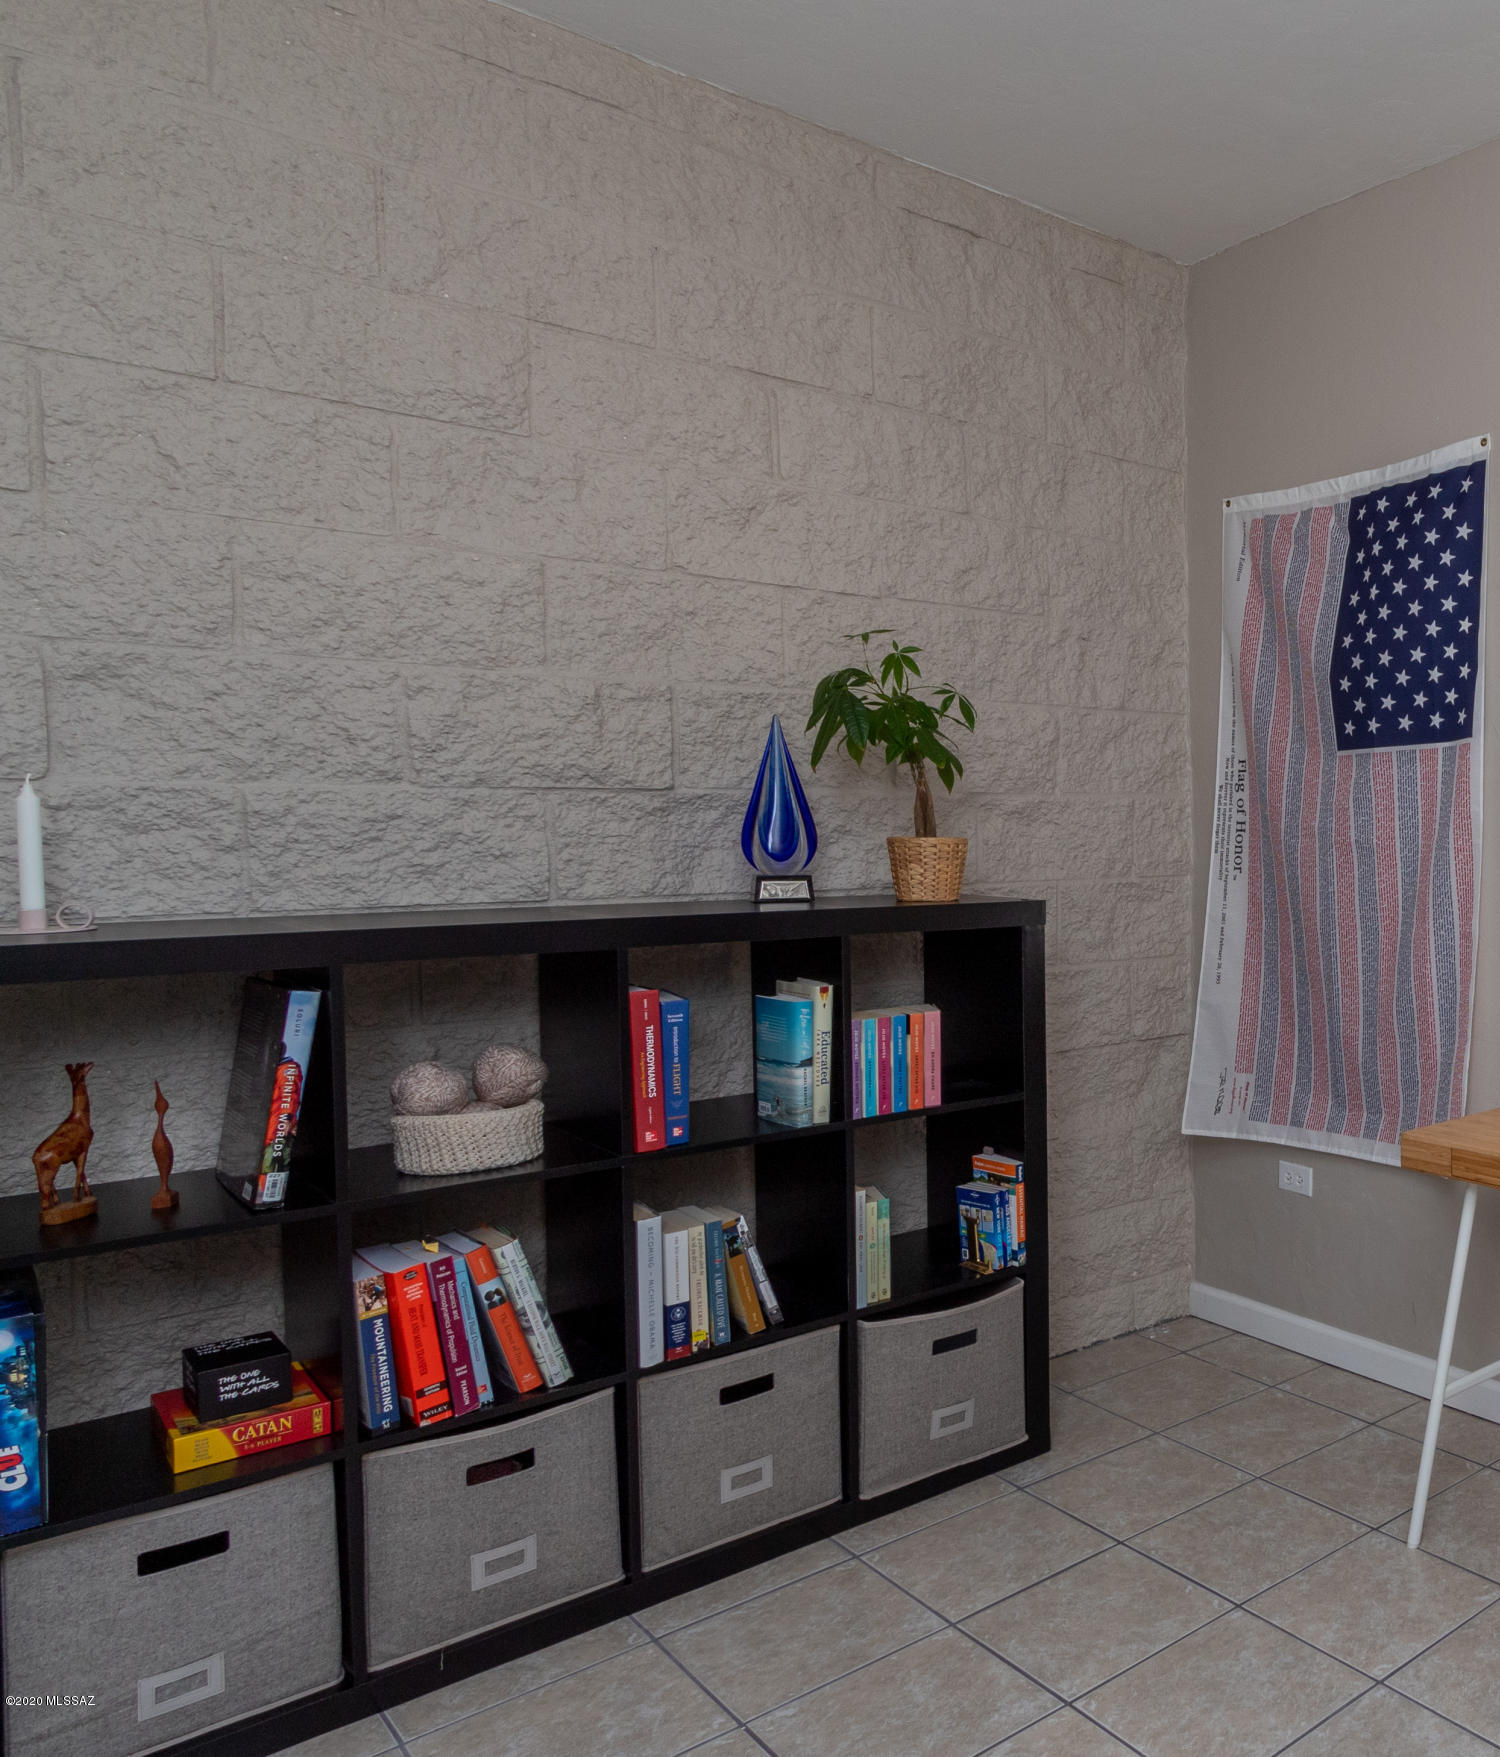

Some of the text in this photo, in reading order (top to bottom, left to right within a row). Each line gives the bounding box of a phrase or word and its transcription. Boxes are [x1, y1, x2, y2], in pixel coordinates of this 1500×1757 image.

[1234, 759, 1246, 874] Flag of Honor
[672, 1026, 680, 1056] Introduction
[645, 1024, 656, 1098] THERMODYNAMICS
[820, 1031, 830, 1085] Educated
[672, 1064, 682, 1096] FLIGHT
[272, 1064, 296, 1157] INFINITE WORLDS
[647, 1227, 655, 1268] BECOMING
[446, 1280, 460, 1320] Mechanics and
[648, 1280, 656, 1317] MICHELLE
[715, 1294, 723, 1315] CALLED
[438, 1284, 450, 1328] Thermodynamics
[446, 1336, 458, 1363] Propulsion
[219, 1370, 261, 1385] THE ONE
[373, 1318, 393, 1412] MOUNTAINEERING
[219, 1381, 280, 1401] THE CARDS
[220, 1376, 270, 1392] WITH ALL
[459, 1380, 470, 1405] PEARSON
[423, 1404, 448, 1417] WILEY
[232, 1416, 293, 1442] CATAN
[257, 1436, 282, 1448] PLAYER
